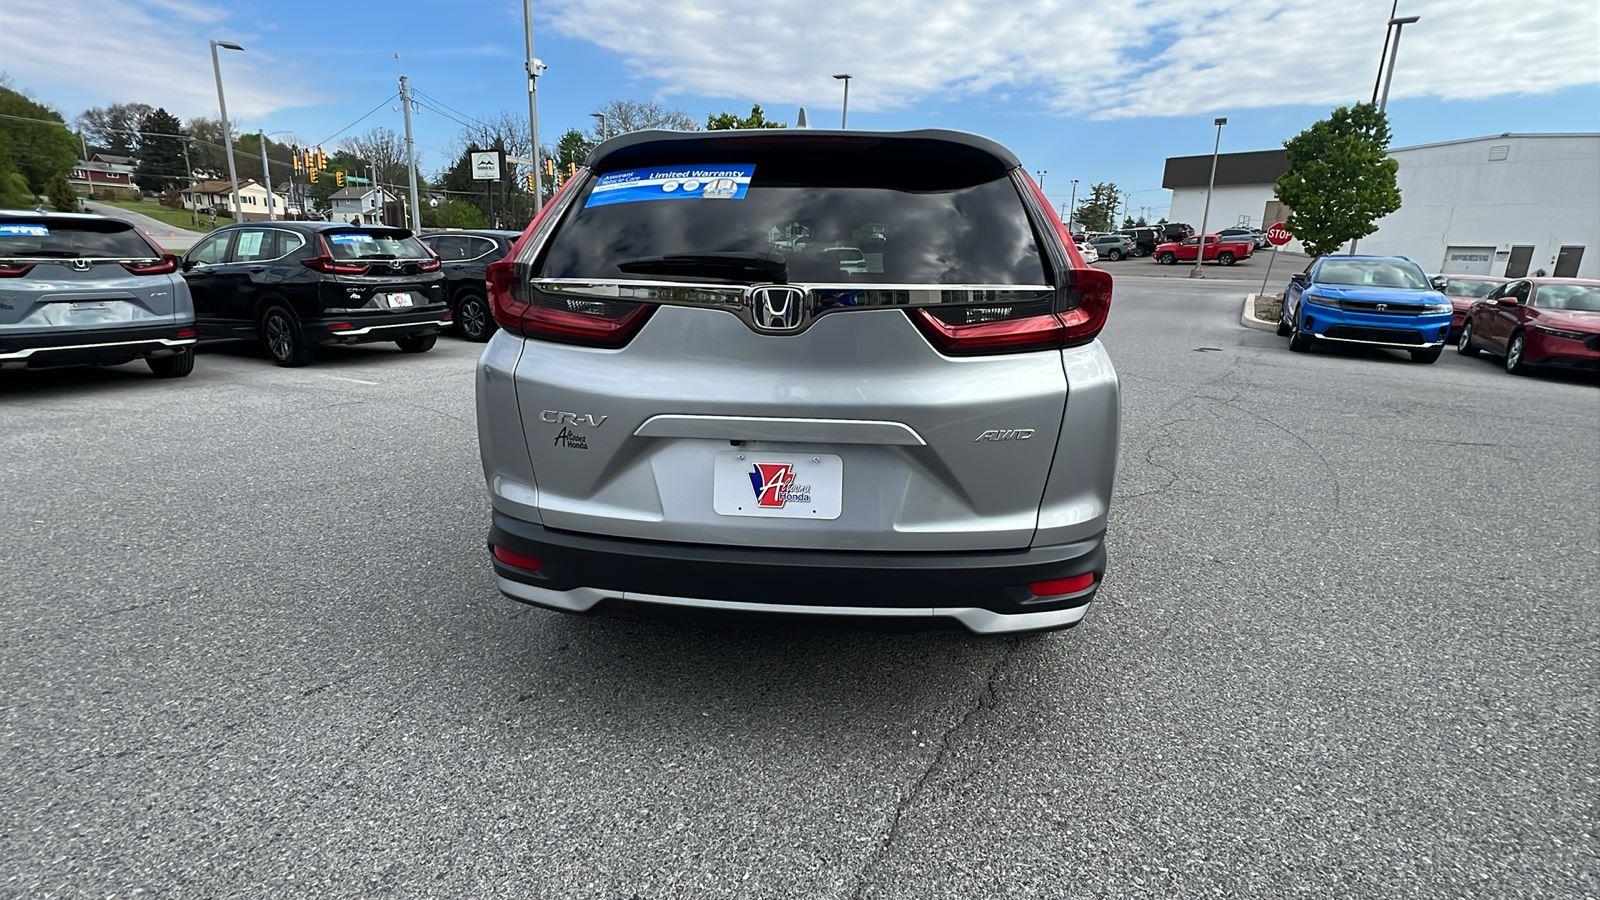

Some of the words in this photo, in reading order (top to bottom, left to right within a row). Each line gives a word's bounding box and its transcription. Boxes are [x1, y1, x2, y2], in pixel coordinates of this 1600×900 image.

[604, 171, 634, 181] Assurant
[649, 170, 690, 179] Limited
[691, 170, 745, 179] Warranty
[1268, 228, 1293, 240] STOP
[539, 409, 608, 428] CR-V
[974, 428, 1035, 442] AWD
[567, 440, 588, 450] Honda
[778, 492, 811, 503] Honda
